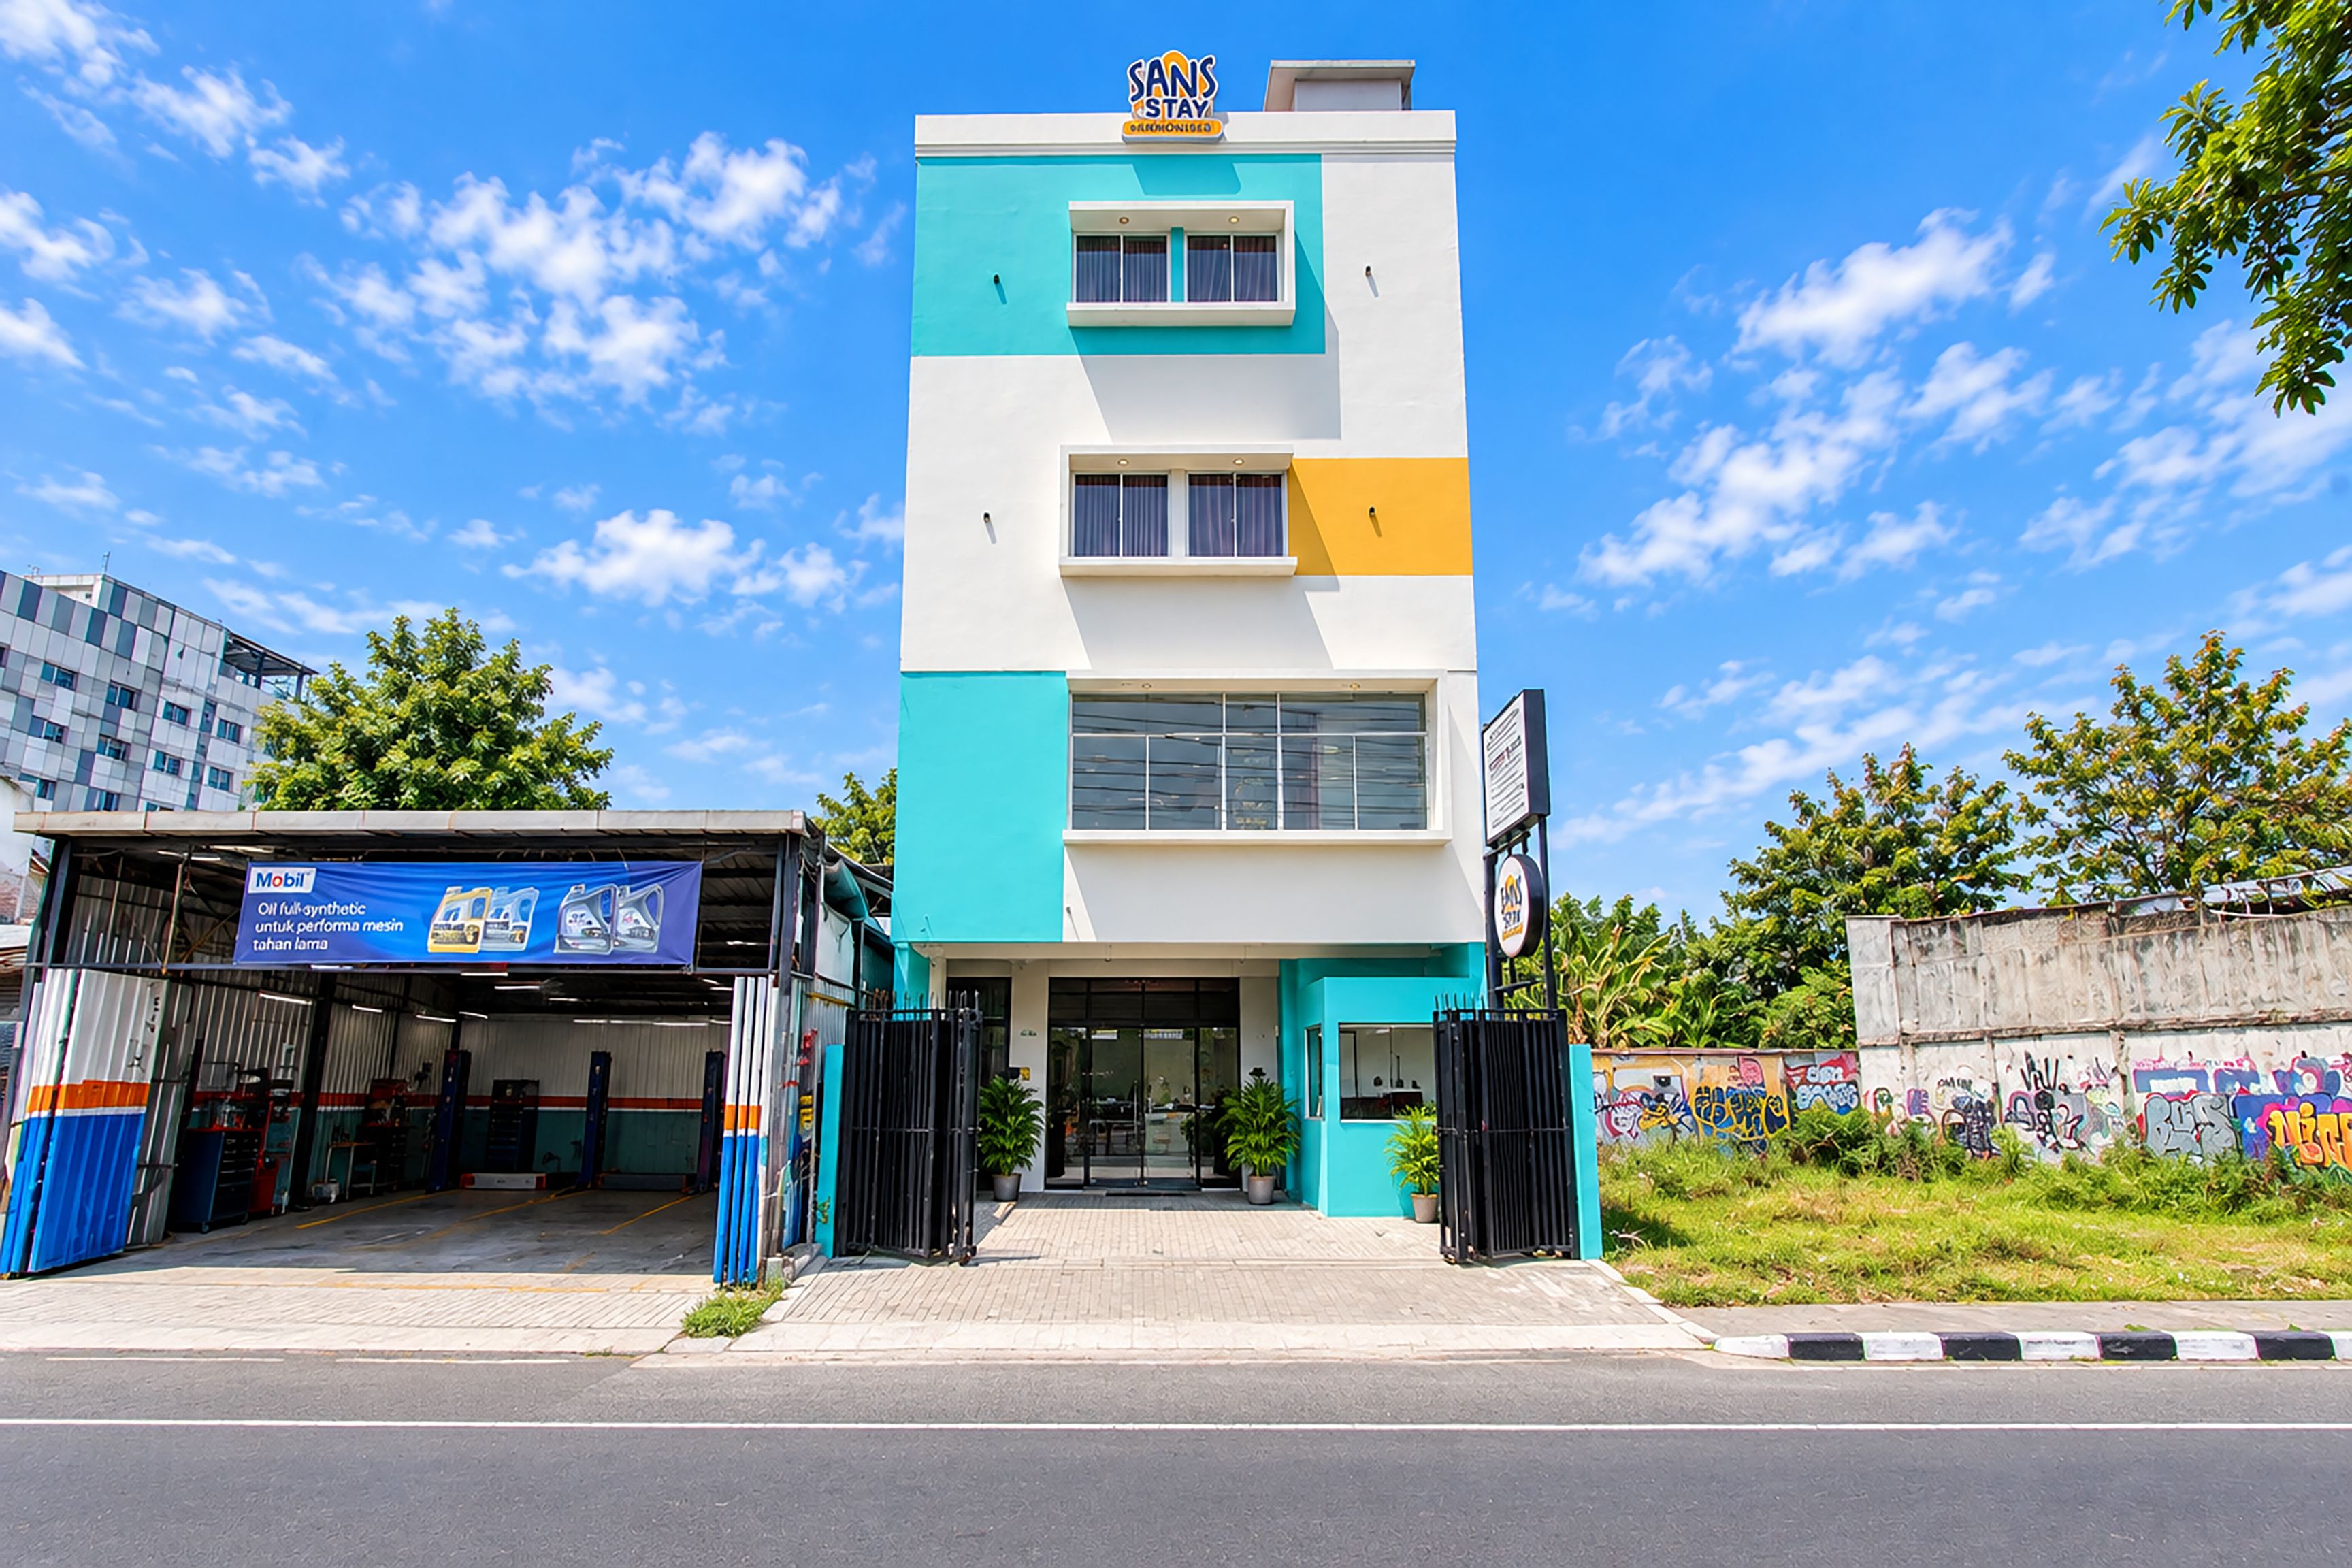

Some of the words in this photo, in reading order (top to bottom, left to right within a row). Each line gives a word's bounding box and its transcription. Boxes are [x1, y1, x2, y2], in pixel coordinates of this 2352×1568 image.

[1129, 56, 1216, 102] SANS
[1145, 98, 1209, 118] STAY
[256, 872, 304, 887] Mobil
[255, 919, 295, 933] untuk
[296, 918, 360, 934] performa
[363, 918, 404, 931] mesin
[253, 936, 292, 951] tahan
[294, 936, 328, 950] lama
